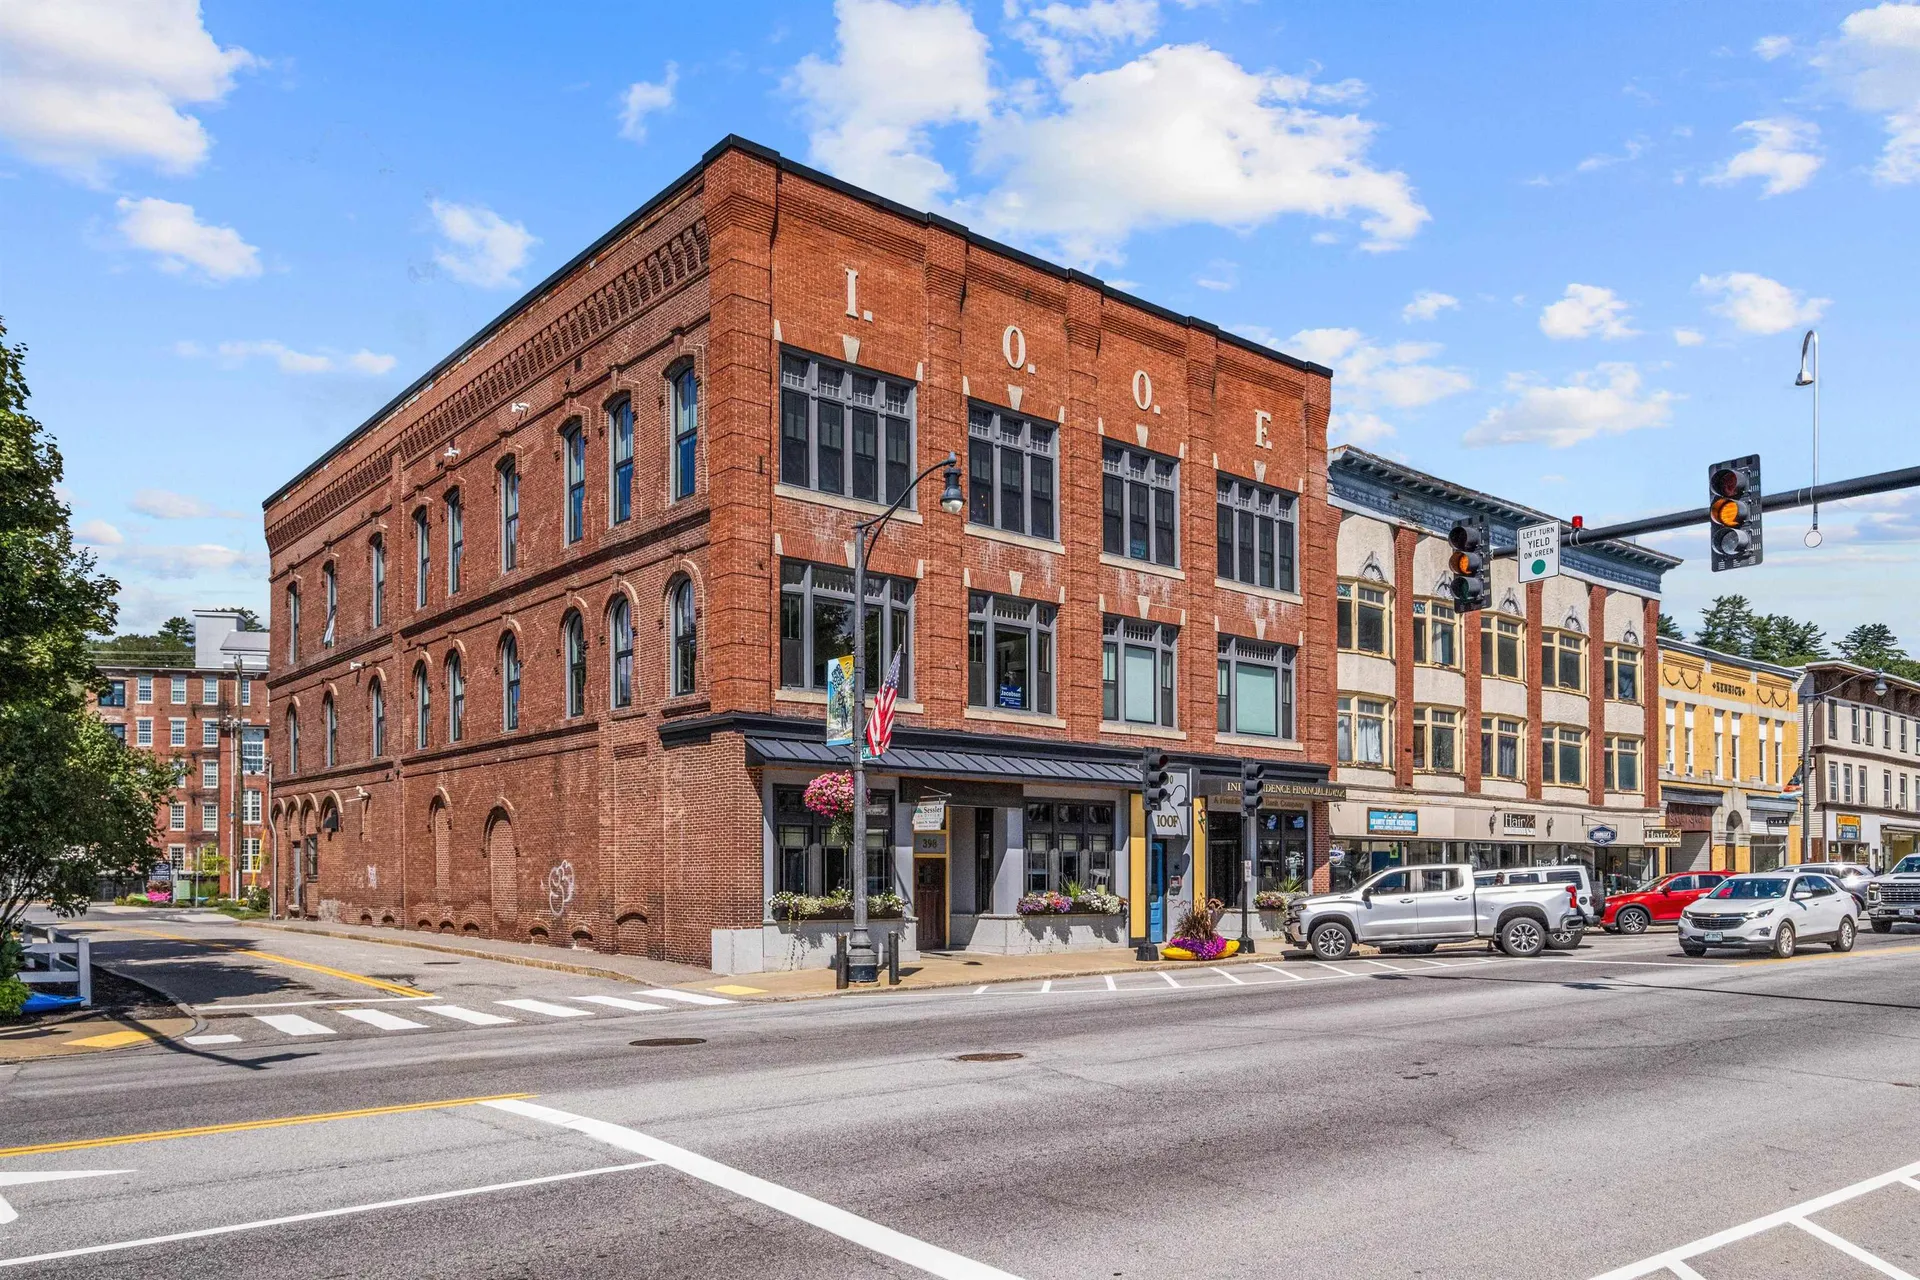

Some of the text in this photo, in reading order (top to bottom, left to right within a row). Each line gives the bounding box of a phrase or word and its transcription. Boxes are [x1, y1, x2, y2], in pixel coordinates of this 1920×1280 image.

[1523, 527, 1555, 539] LEFT TURN
[1528, 537, 1550, 549] YIELD
[1523, 548, 1554, 560] ON GREEN
[923, 806, 942, 814] Sessler
[1156, 814, 1179, 828] IOOF
[1505, 813, 1526, 828] Hair
[1646, 830, 1669, 839] Hair
[922, 838, 938, 849] 398
